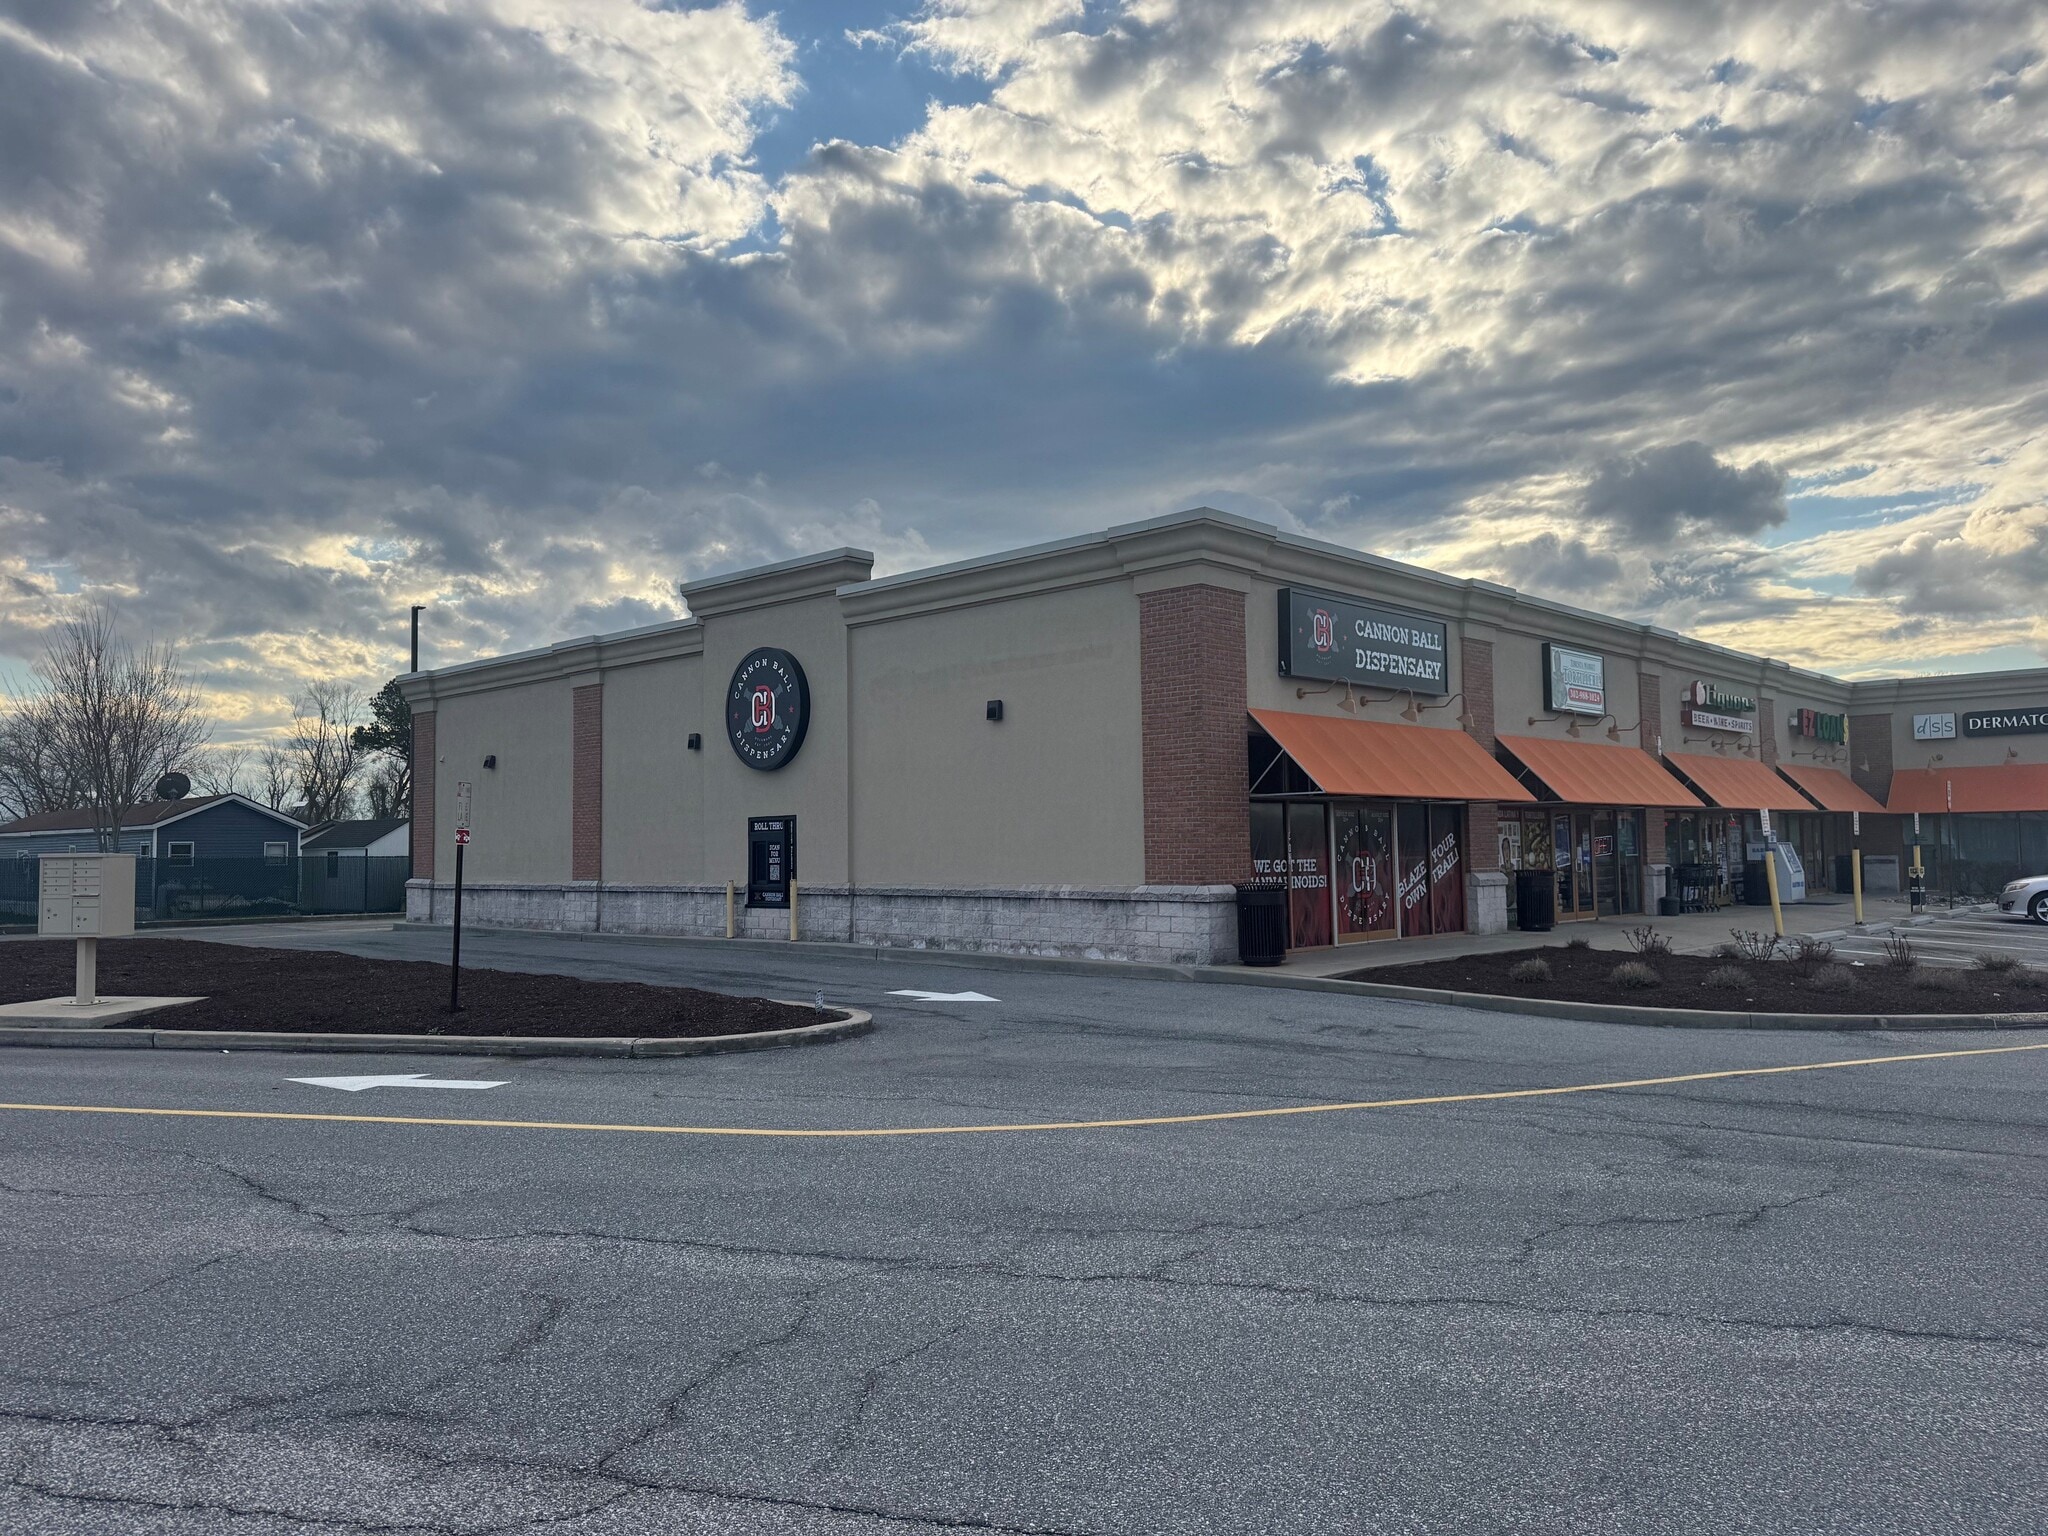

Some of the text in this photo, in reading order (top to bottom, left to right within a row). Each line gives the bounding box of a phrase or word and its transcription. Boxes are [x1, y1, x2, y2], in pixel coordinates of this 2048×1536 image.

[1355, 619, 1442, 651] CANNON BALL
[735, 658, 793, 700] CANNON BALL
[1355, 649, 1442, 680] DISPENSARY
[1693, 713, 1753, 731] BEER WINE SPIRITS
[1802, 708, 1849, 746] EZ LOANS
[736, 725, 791, 760] DISPENSARY
[754, 821, 784, 831] ROLL THRU
[1373, 829, 1390, 861] BALL
[1253, 859, 1317, 873] WE GOT THE
[1398, 832, 1456, 898] BLAZE YOUR
[1405, 847, 1460, 910] OWN TRAIL!
